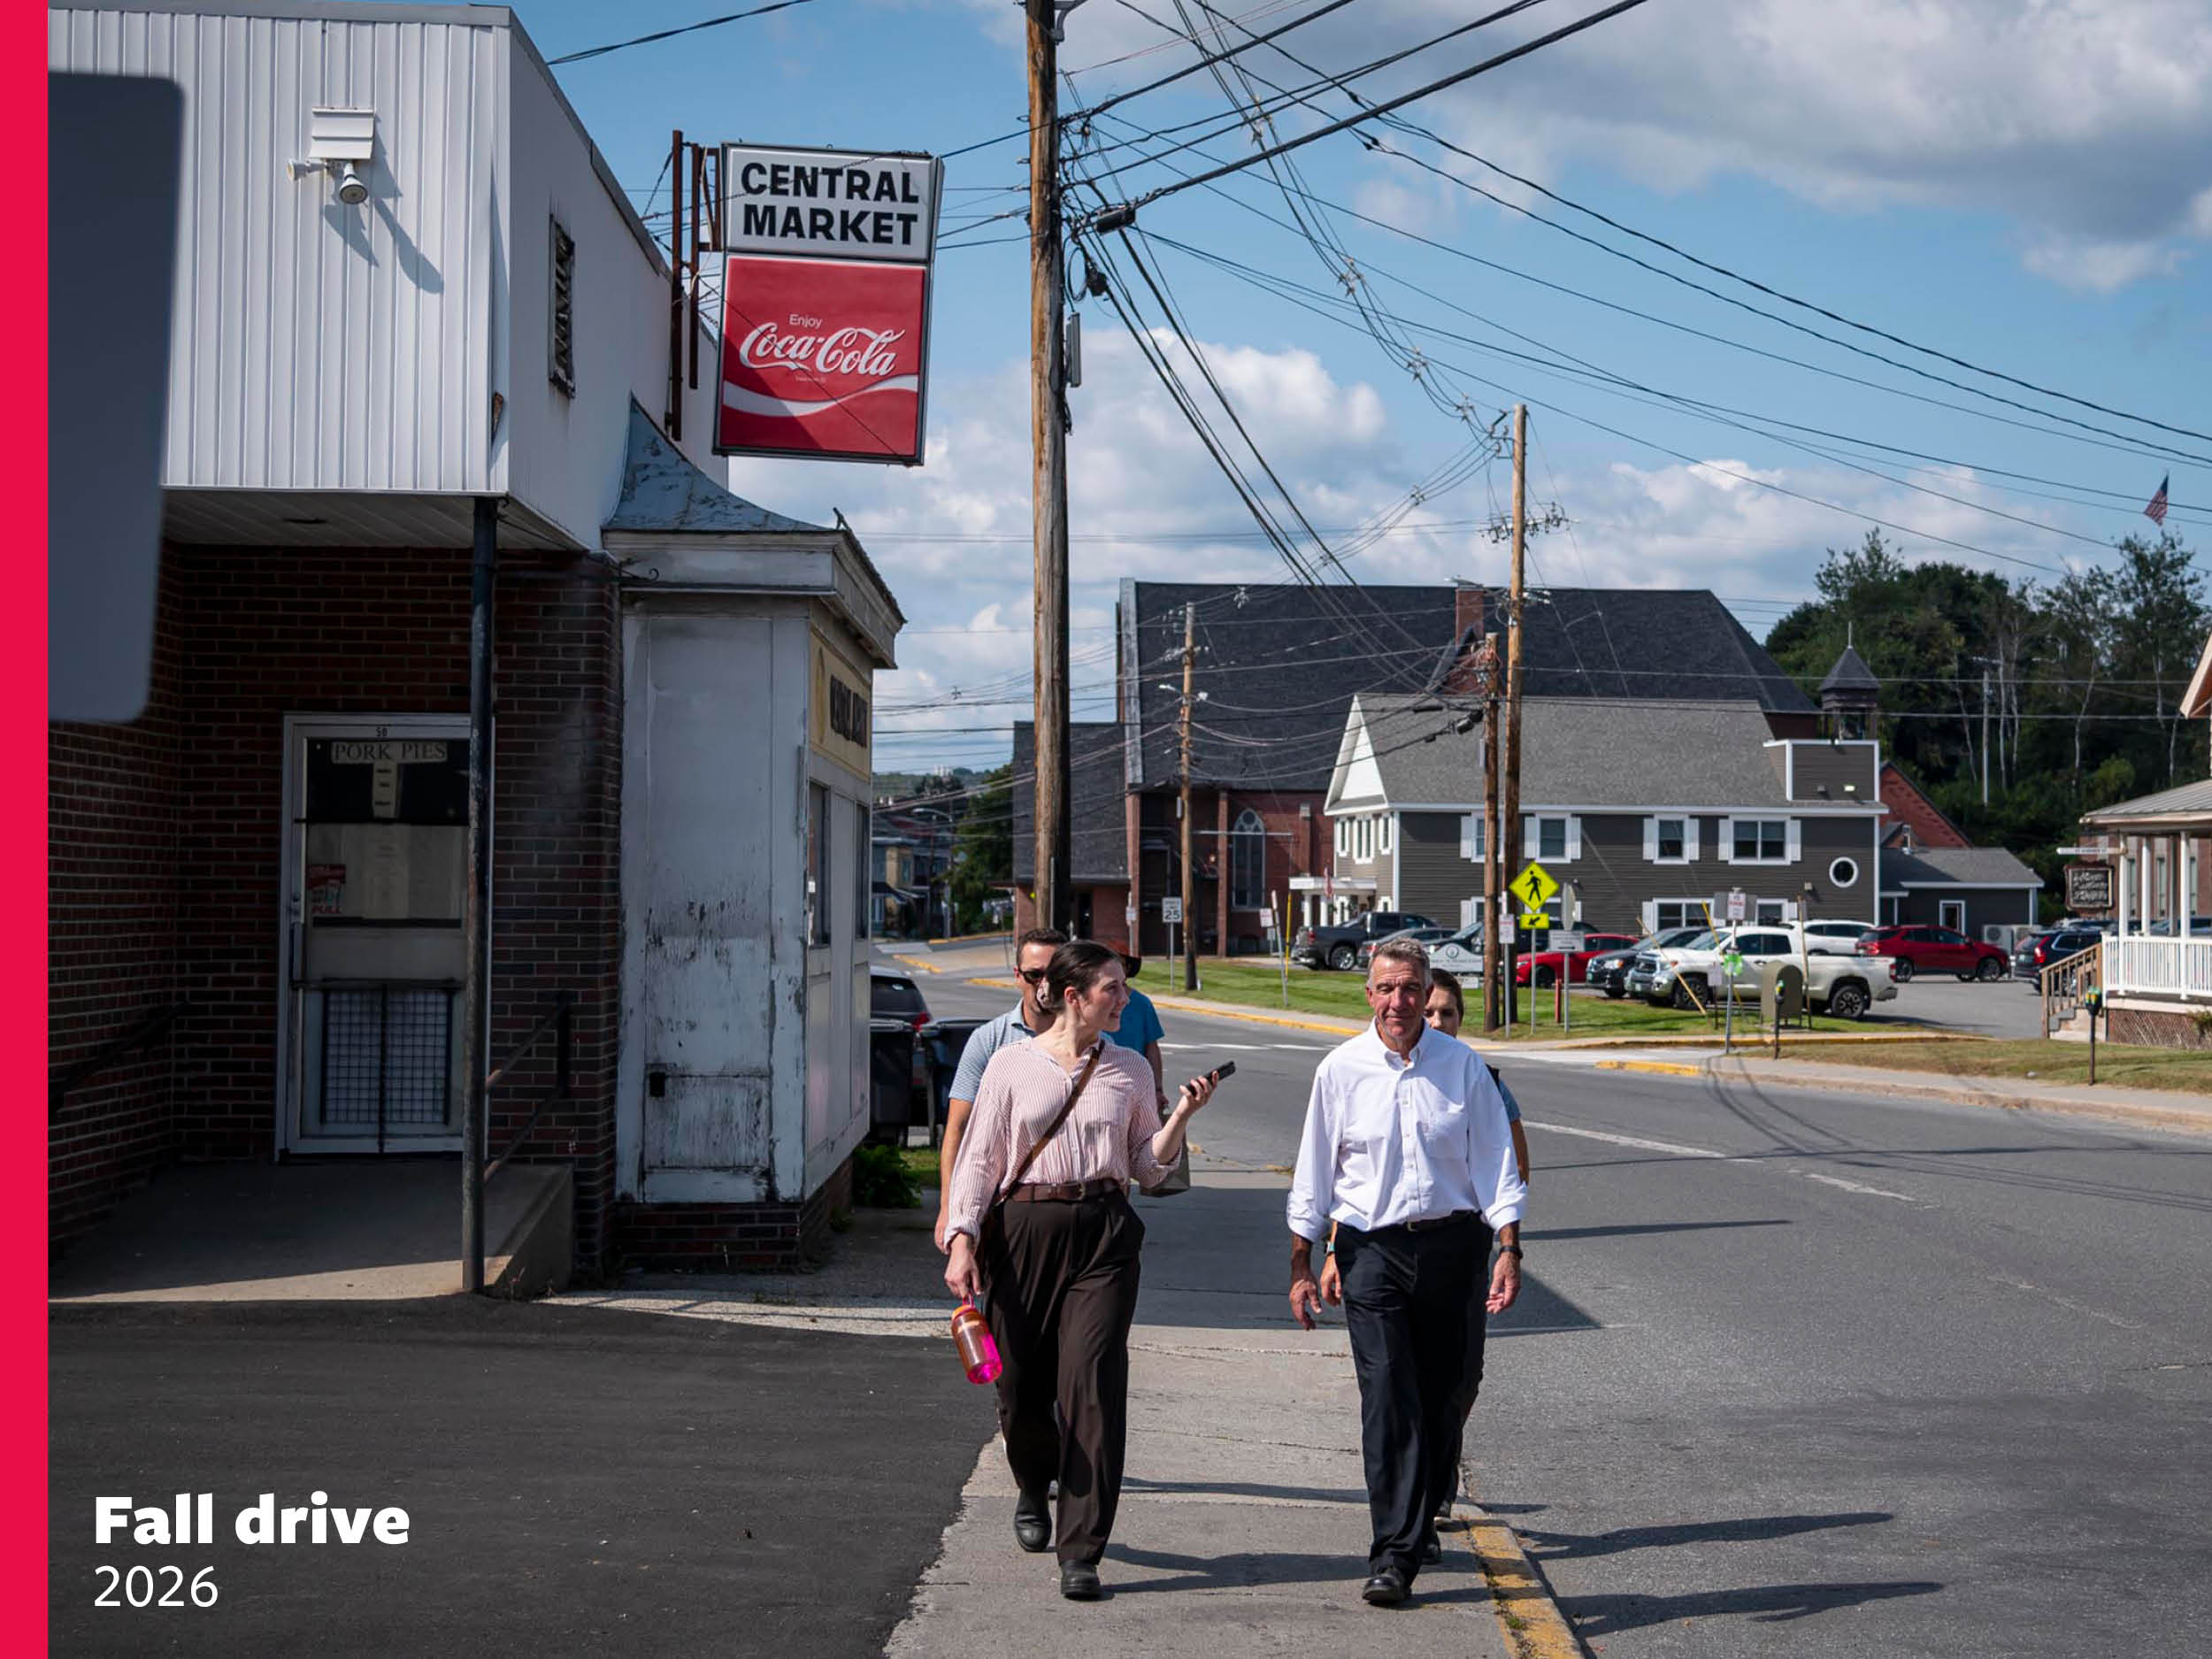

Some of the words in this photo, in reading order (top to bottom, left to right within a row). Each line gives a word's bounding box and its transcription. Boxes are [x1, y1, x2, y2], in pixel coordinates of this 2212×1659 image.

[741, 162, 919, 204] CENTRAL
[742, 204, 918, 245] MARKET
[789, 313, 823, 328] Enjoy
[740, 322, 905, 376] Coca-Cola
[334, 742, 393, 761] PORK
[402, 741, 446, 759] PIES
[1164, 910, 1180, 920] 25
